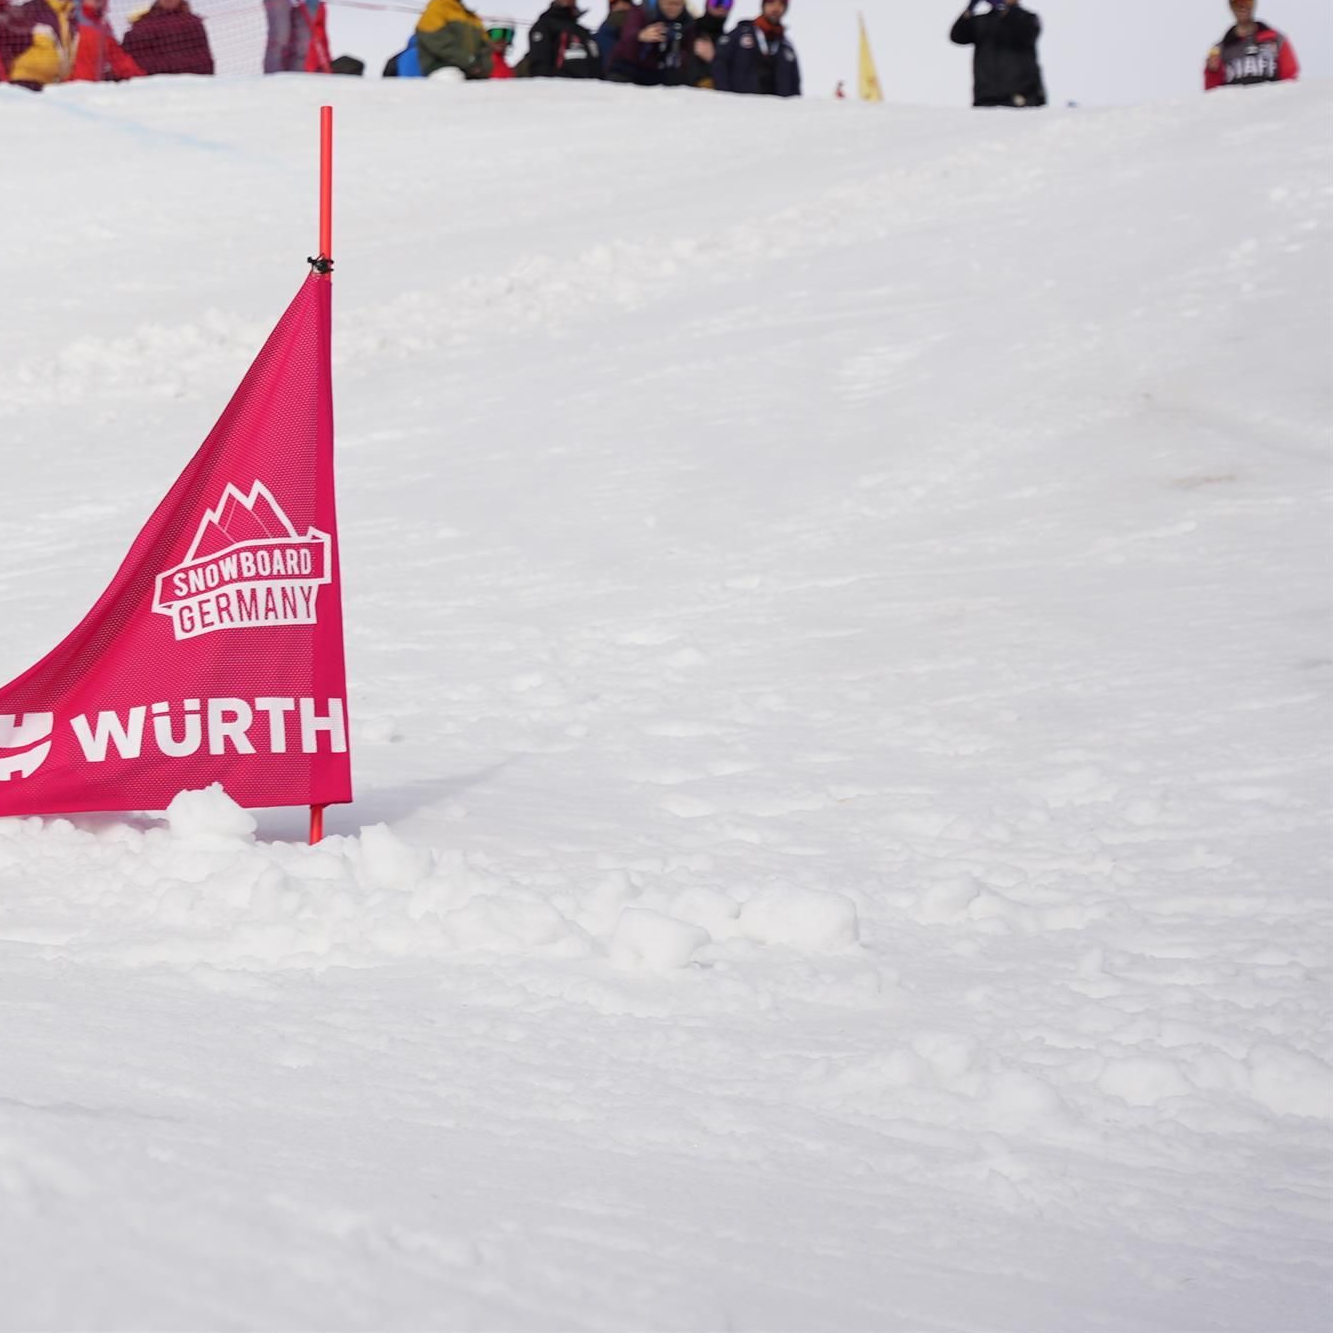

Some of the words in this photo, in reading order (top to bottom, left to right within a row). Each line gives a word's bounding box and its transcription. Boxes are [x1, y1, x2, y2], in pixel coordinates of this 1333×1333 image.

[173, 548, 312, 597] SNOWBOARD
[178, 585, 313, 634] GERMANY
[69, 698, 347, 763] WÜRTH
